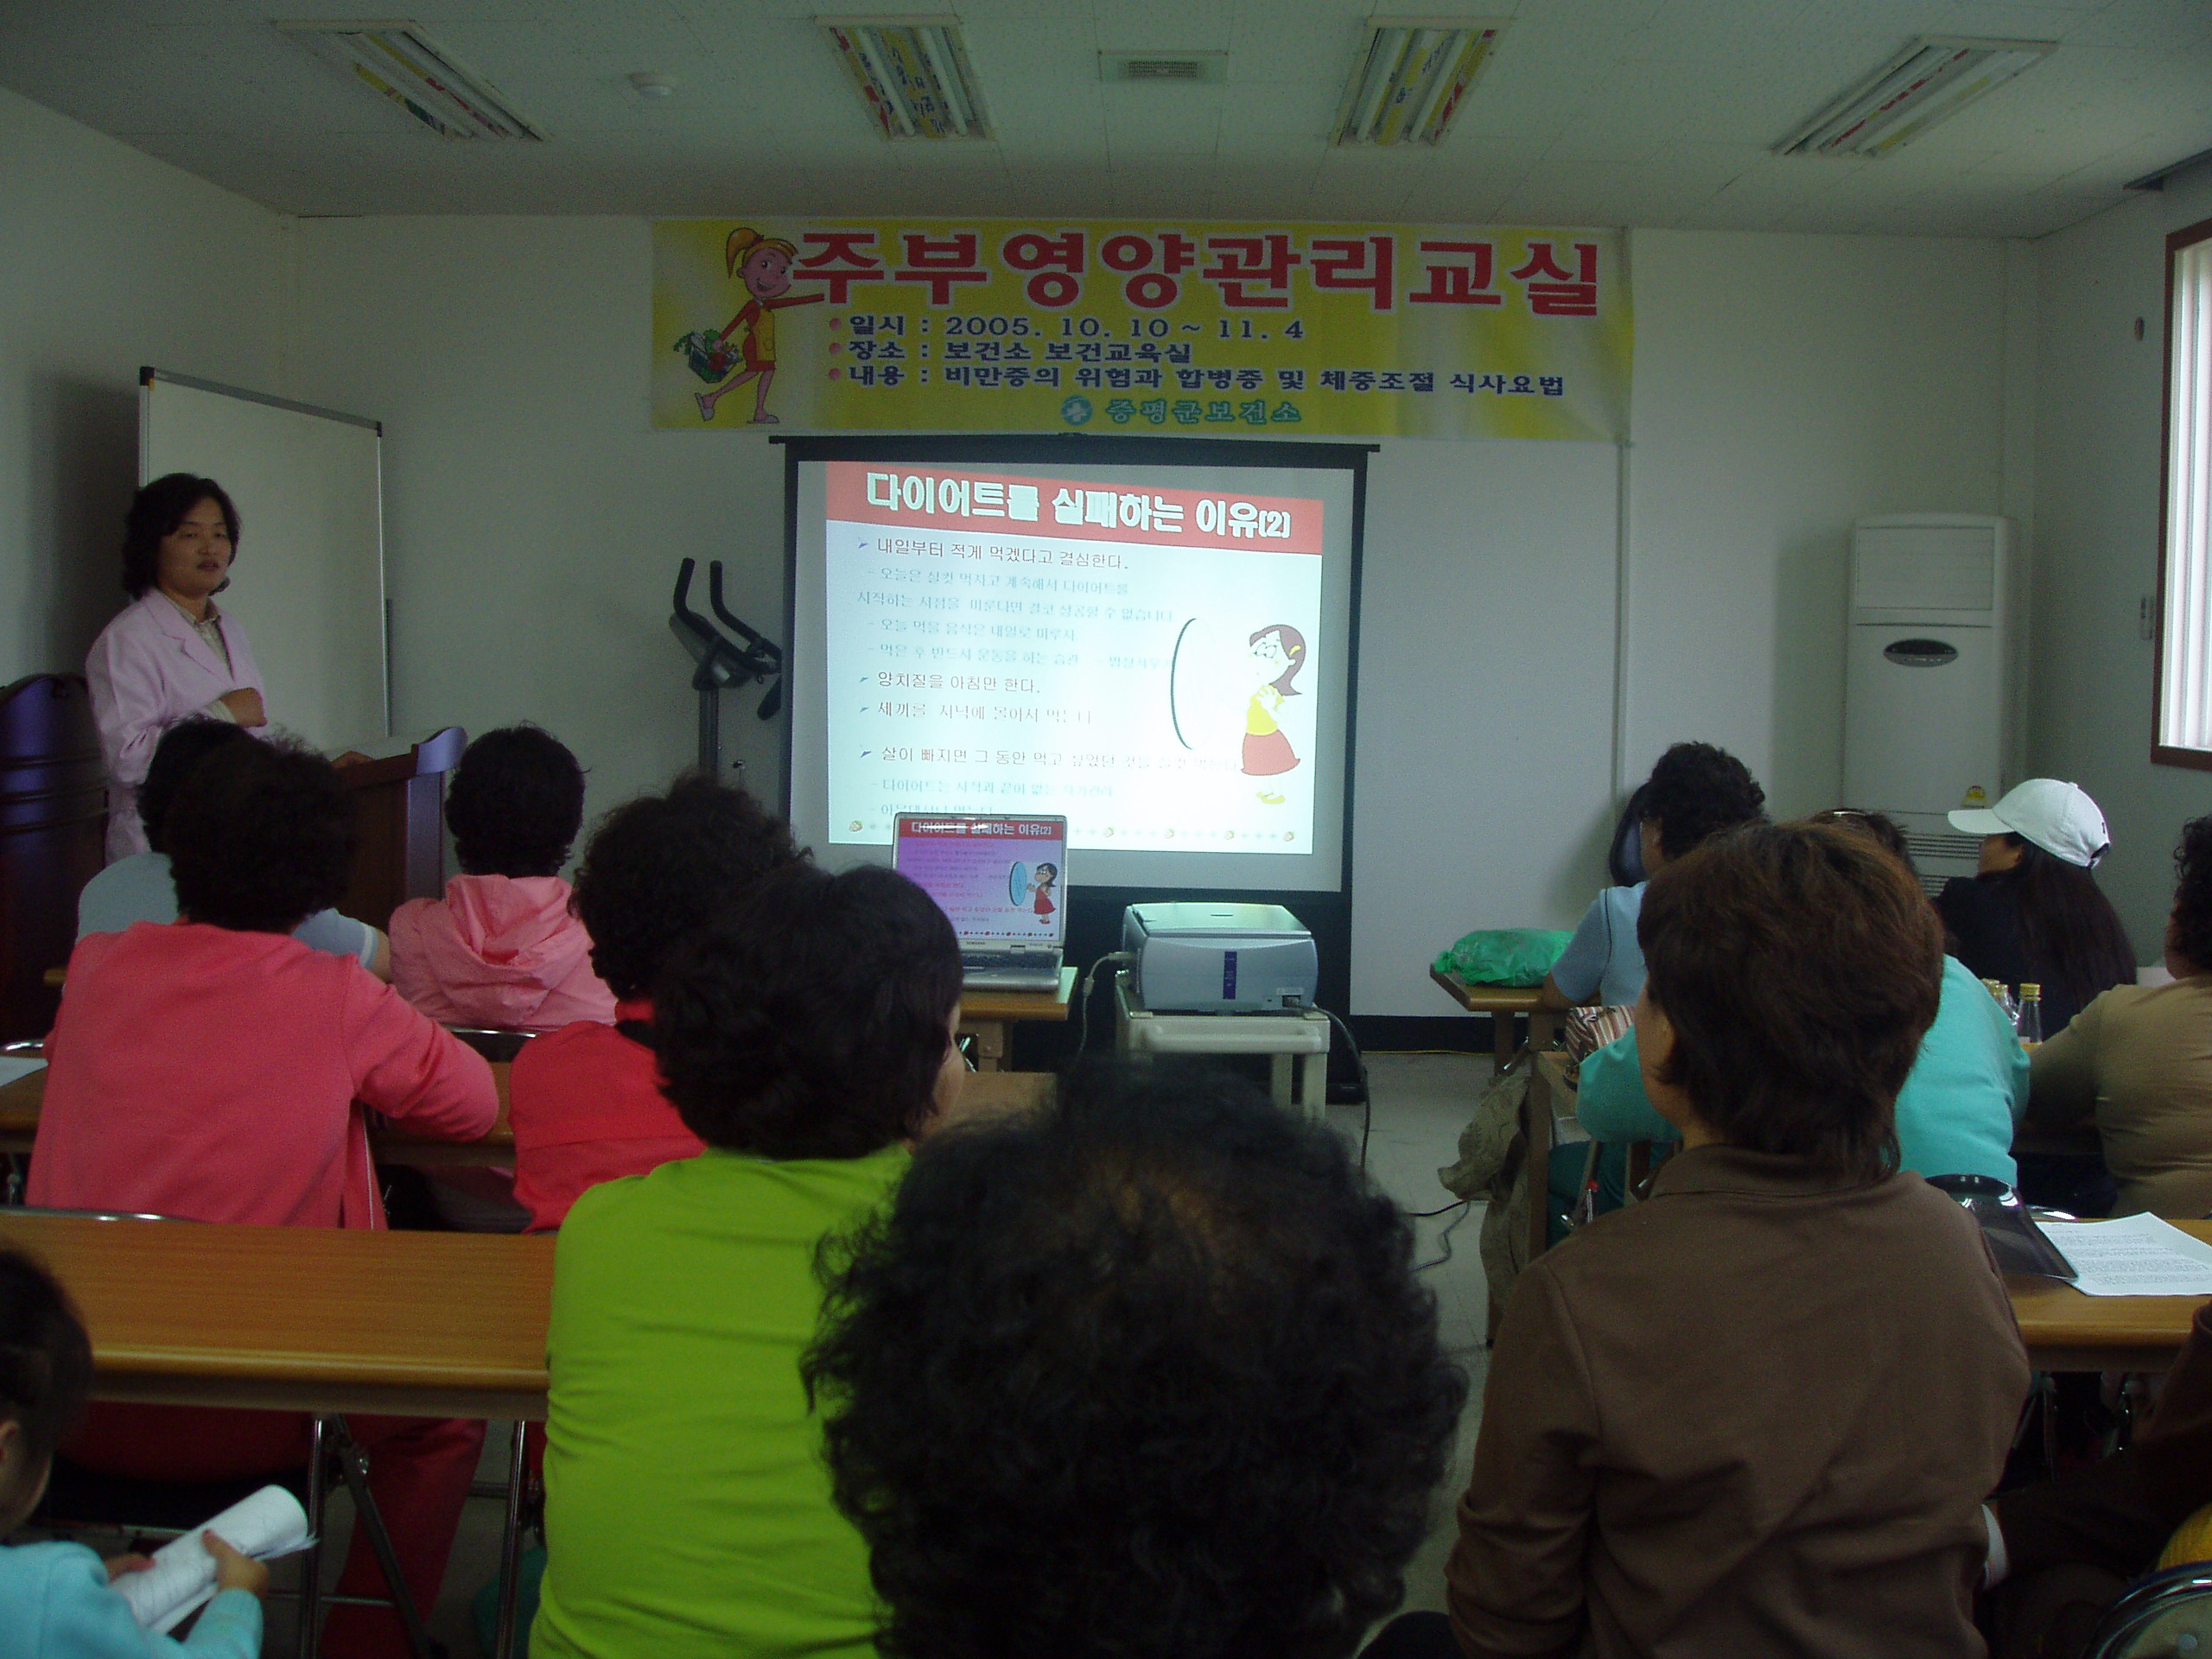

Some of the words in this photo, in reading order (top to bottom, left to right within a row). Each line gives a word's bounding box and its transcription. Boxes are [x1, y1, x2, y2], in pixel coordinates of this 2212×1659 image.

[849, 315, 906, 335] 일시
[945, 316, 1042, 337] 2005.
[1062, 317, 1111, 338] 10.
[1131, 319, 1170, 339] 10
[1220, 320, 1268, 340] 11.
[1285, 321, 1305, 340] 4
[849, 341, 907, 359] 장소
[944, 342, 1033, 362] 보건소
[1046, 343, 1192, 364] 보건교육실
[849, 366, 906, 388] 내용
[944, 366, 1060, 388] 비만증의
[1075, 367, 1164, 389] 위험과
[1176, 369, 1264, 391] 합병증
[1278, 370, 1305, 391] 및
[1320, 371, 1435, 393] 체중조절
[1449, 374, 1565, 397] 식사요법
[1105, 397, 1304, 424] 증평군보건소
[866, 471, 1040, 523] 다이어트를
[1052, 487, 1185, 533] 실패하는
[877, 537, 944, 559] 내일부터
[951, 543, 982, 561] 적게
[989, 545, 1054, 564] 먹겠다고
[1059, 550, 1129, 570] 결심한다.
[857, 591, 913, 608] 시작하는
[878, 671, 944, 690] 양치질을
[950, 675, 998, 692] 아침만
[1004, 677, 1041, 695] 한다.
[877, 700, 926, 719] 세끼를
[881, 745, 914, 763] 살이
[920, 747, 968, 764] 빠지면
[974, 749, 989, 764] 그
[995, 750, 1027, 766] 동안
